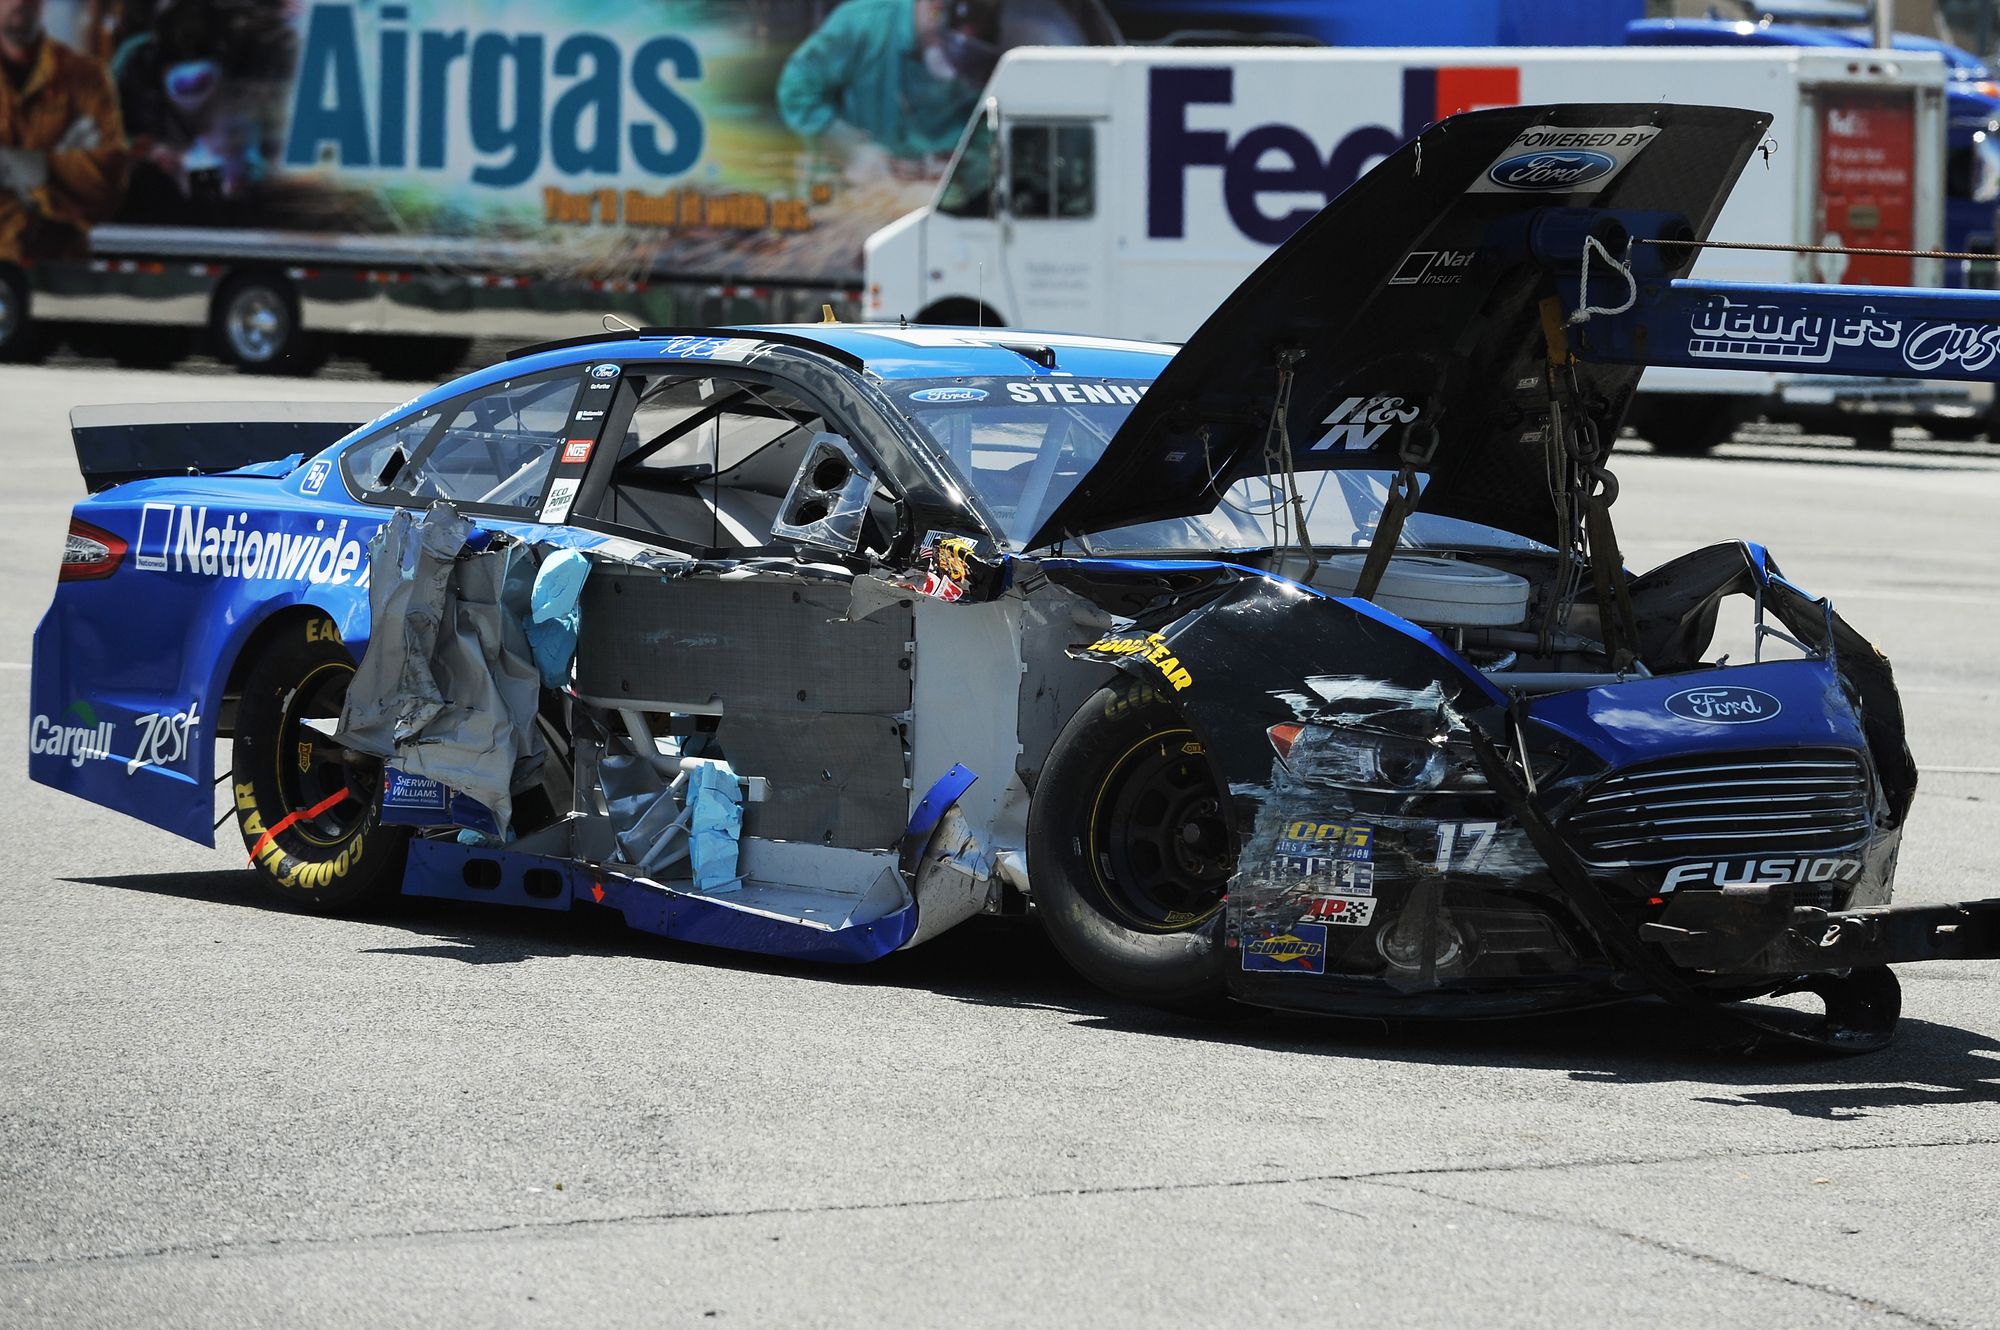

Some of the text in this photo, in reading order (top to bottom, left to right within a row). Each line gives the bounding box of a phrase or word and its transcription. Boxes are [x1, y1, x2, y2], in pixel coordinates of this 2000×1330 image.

[285, 4, 703, 188] Airgas
[1511, 132, 1655, 148] POWERED BY
[1508, 155, 1596, 183] Ford
[566, 443, 591, 457] NOS
[551, 488, 569, 497] ECO
[176, 505, 360, 585] Nationwide
[1687, 691, 1762, 718] Ford
[30, 714, 114, 768] Cargill
[392, 786, 437, 798] WILLIAMS
[396, 776, 437, 788] SHERWIN
[1434, 822, 1498, 873] 17
[1659, 858, 1861, 894] FUSION
[1318, 914, 1359, 924] CAMS
[1249, 940, 1322, 956] SUNOCO
